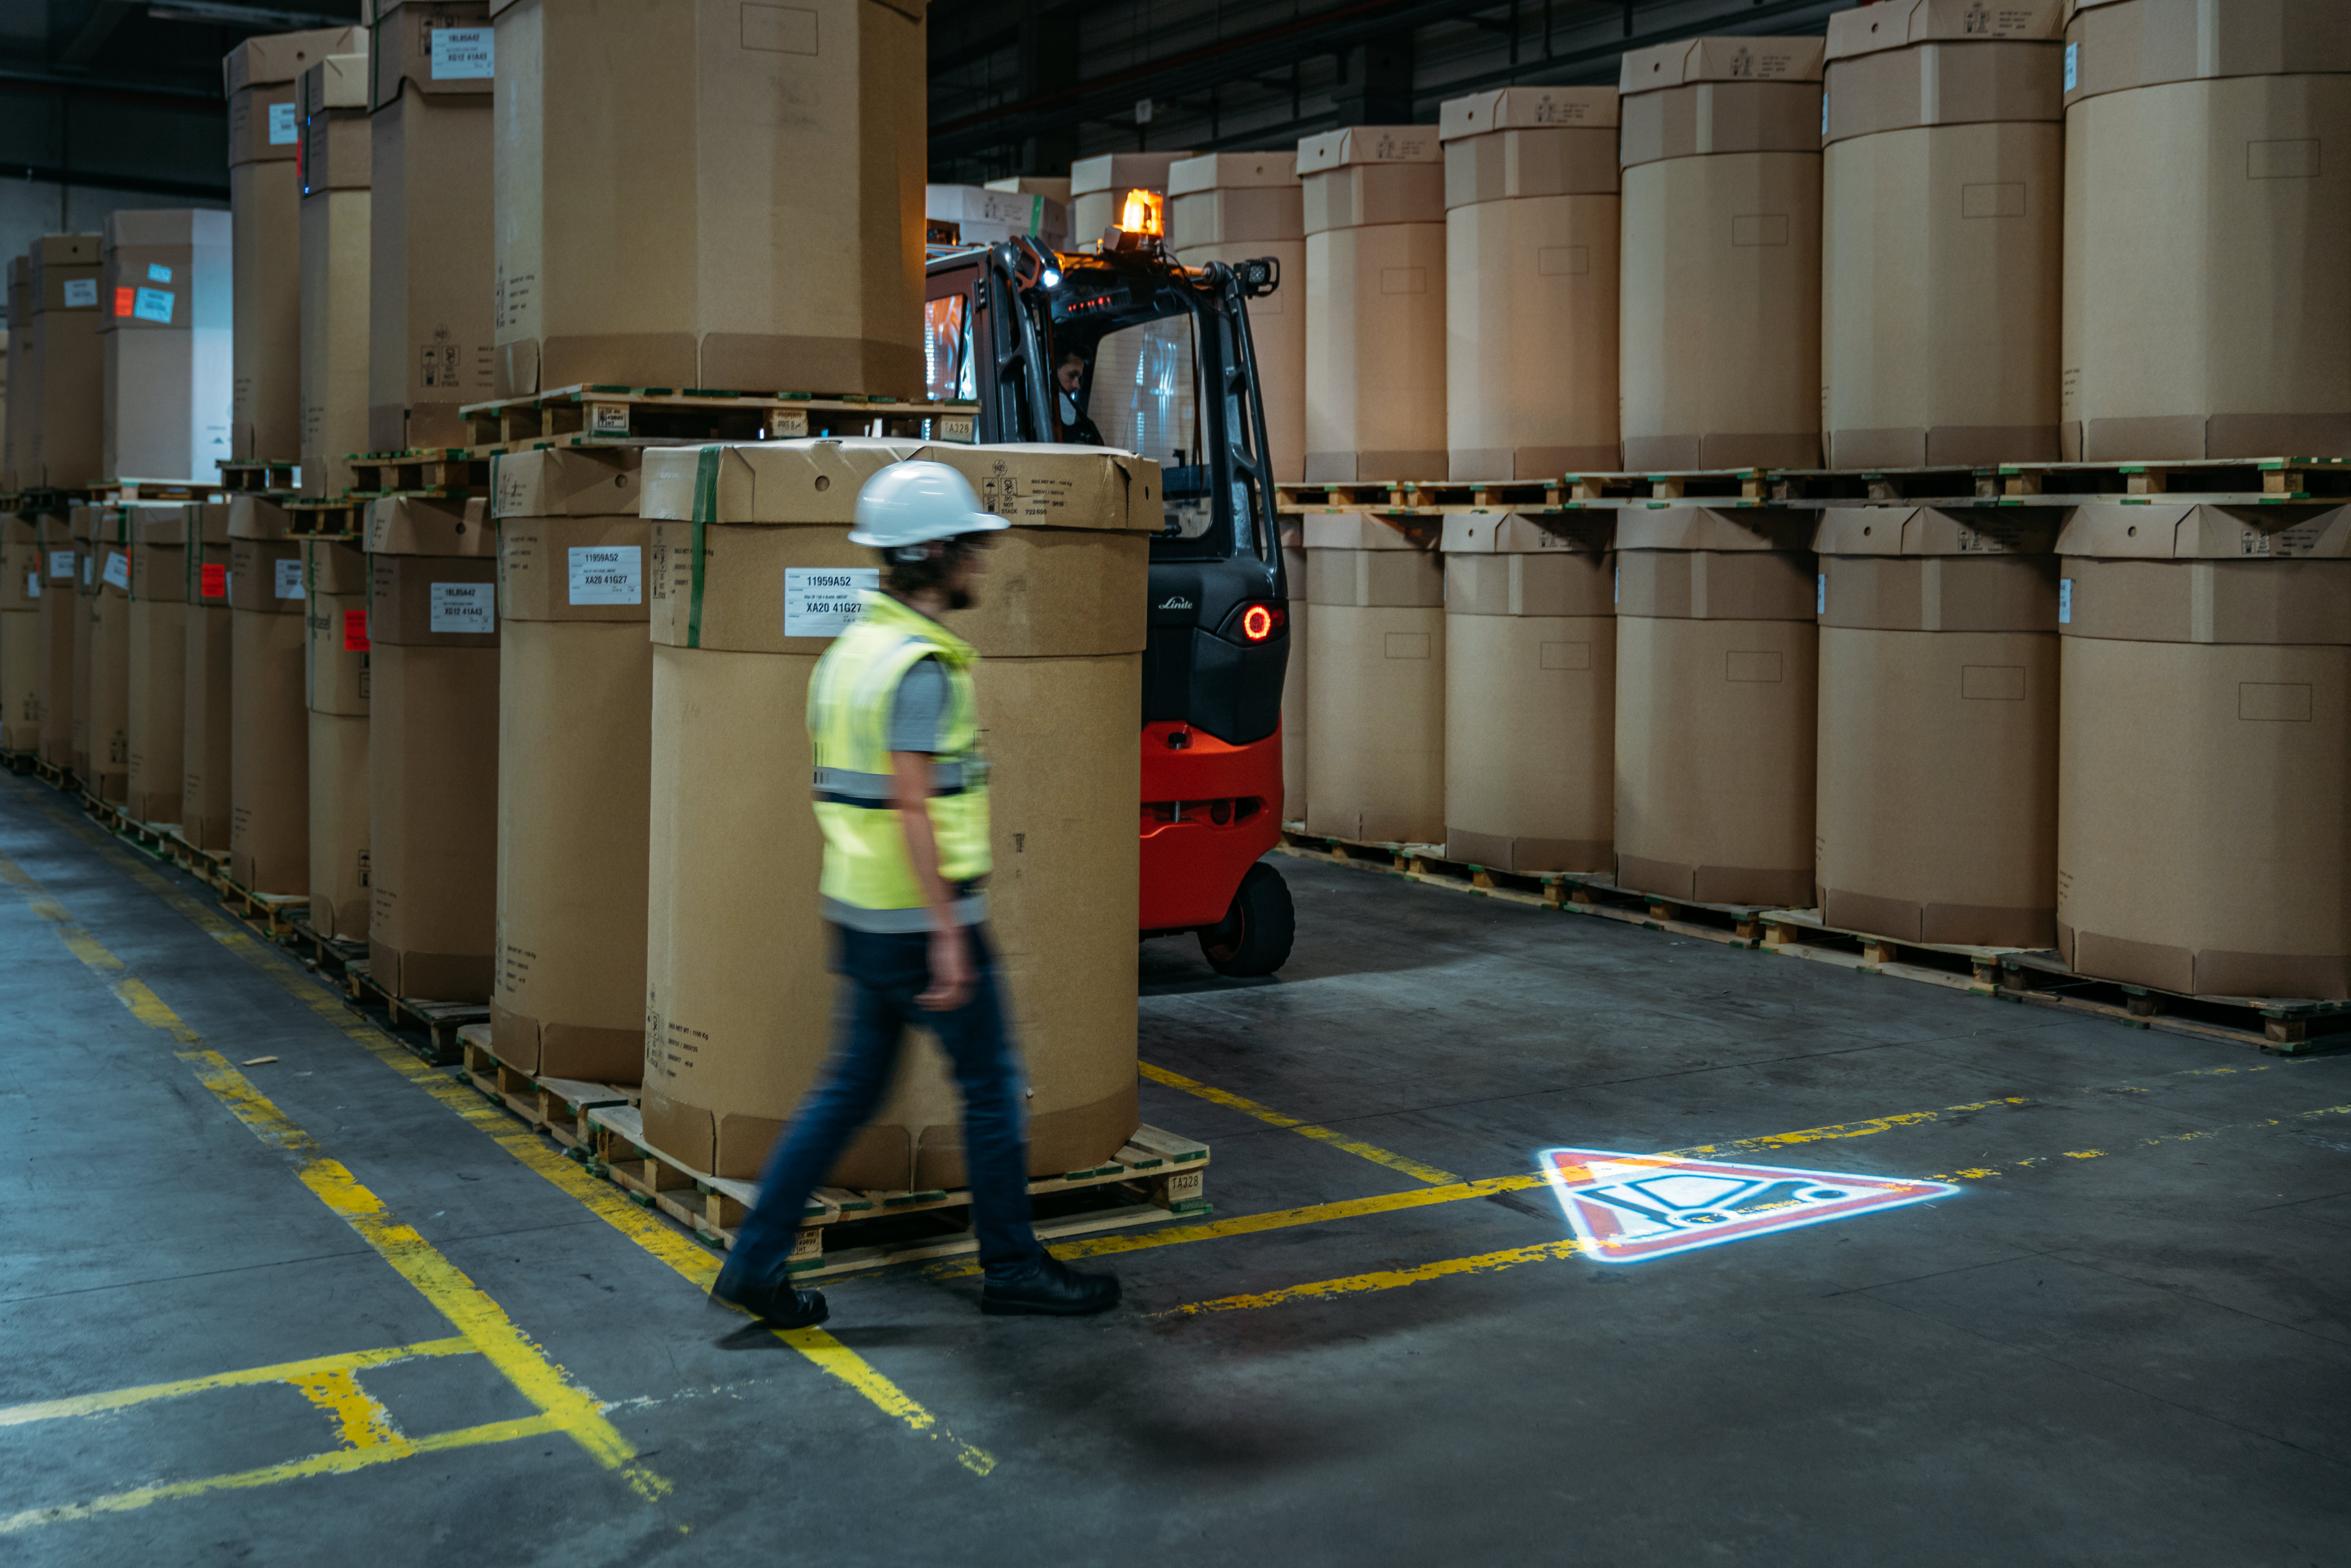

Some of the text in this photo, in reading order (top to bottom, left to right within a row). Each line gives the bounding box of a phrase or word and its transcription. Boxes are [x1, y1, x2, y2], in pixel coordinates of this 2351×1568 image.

[585, 553, 619, 562] 11959A52
[585, 576, 602, 584] XA20
[807, 576, 851, 587] 11959A52
[806, 602, 862, 613] XA20 41G27
[1159, 596, 1192, 609] Linde
[1173, 1175, 1198, 1190] TA328
